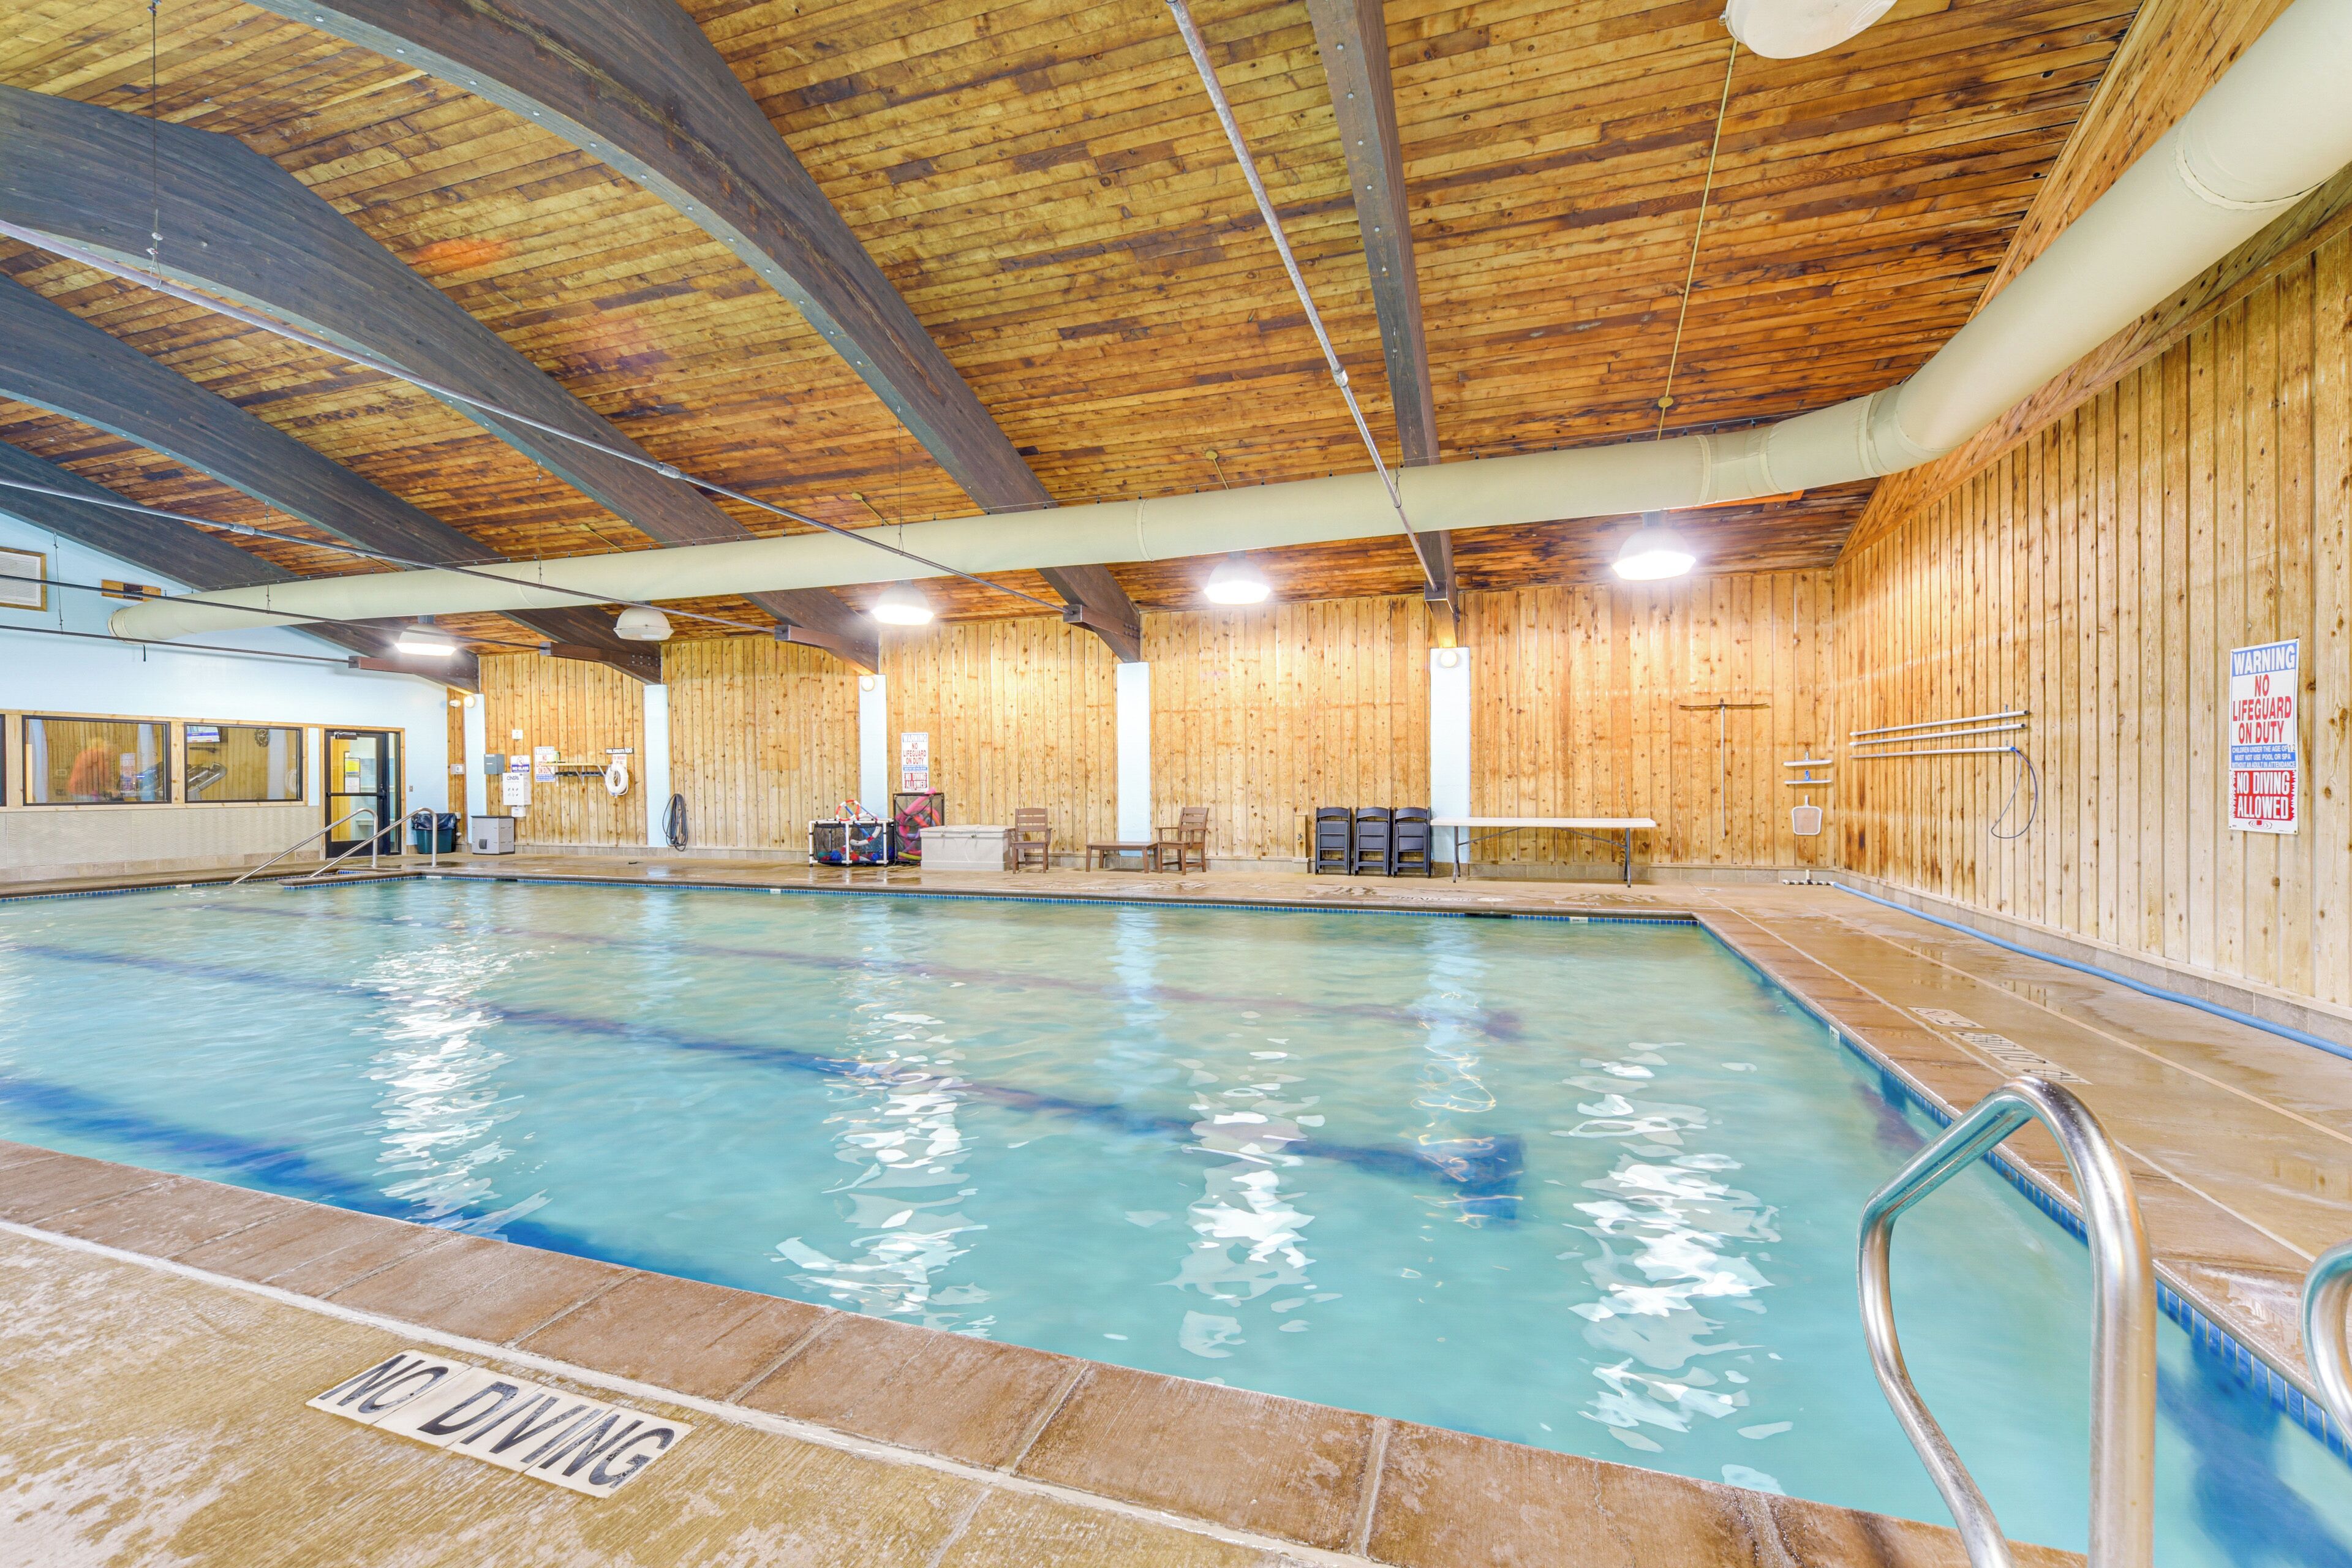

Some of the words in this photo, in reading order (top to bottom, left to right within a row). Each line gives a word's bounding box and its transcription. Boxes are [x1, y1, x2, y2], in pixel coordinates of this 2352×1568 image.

[2234, 645, 2295, 675] WARNING
[2255, 674, 2270, 697] NO
[2233, 696, 2292, 722] LIFEGUARD
[2239, 722, 2252, 744] ON
[2255, 720, 2285, 744] DUTY
[2236, 772, 2249, 794] NO
[2253, 771, 2290, 796] DIVING
[2237, 796, 2289, 820] ALLOWED
[1958, 1032, 2047, 1064] DIVING
[318, 1354, 449, 1414] NO
[417, 1381, 675, 1489] DIVING
